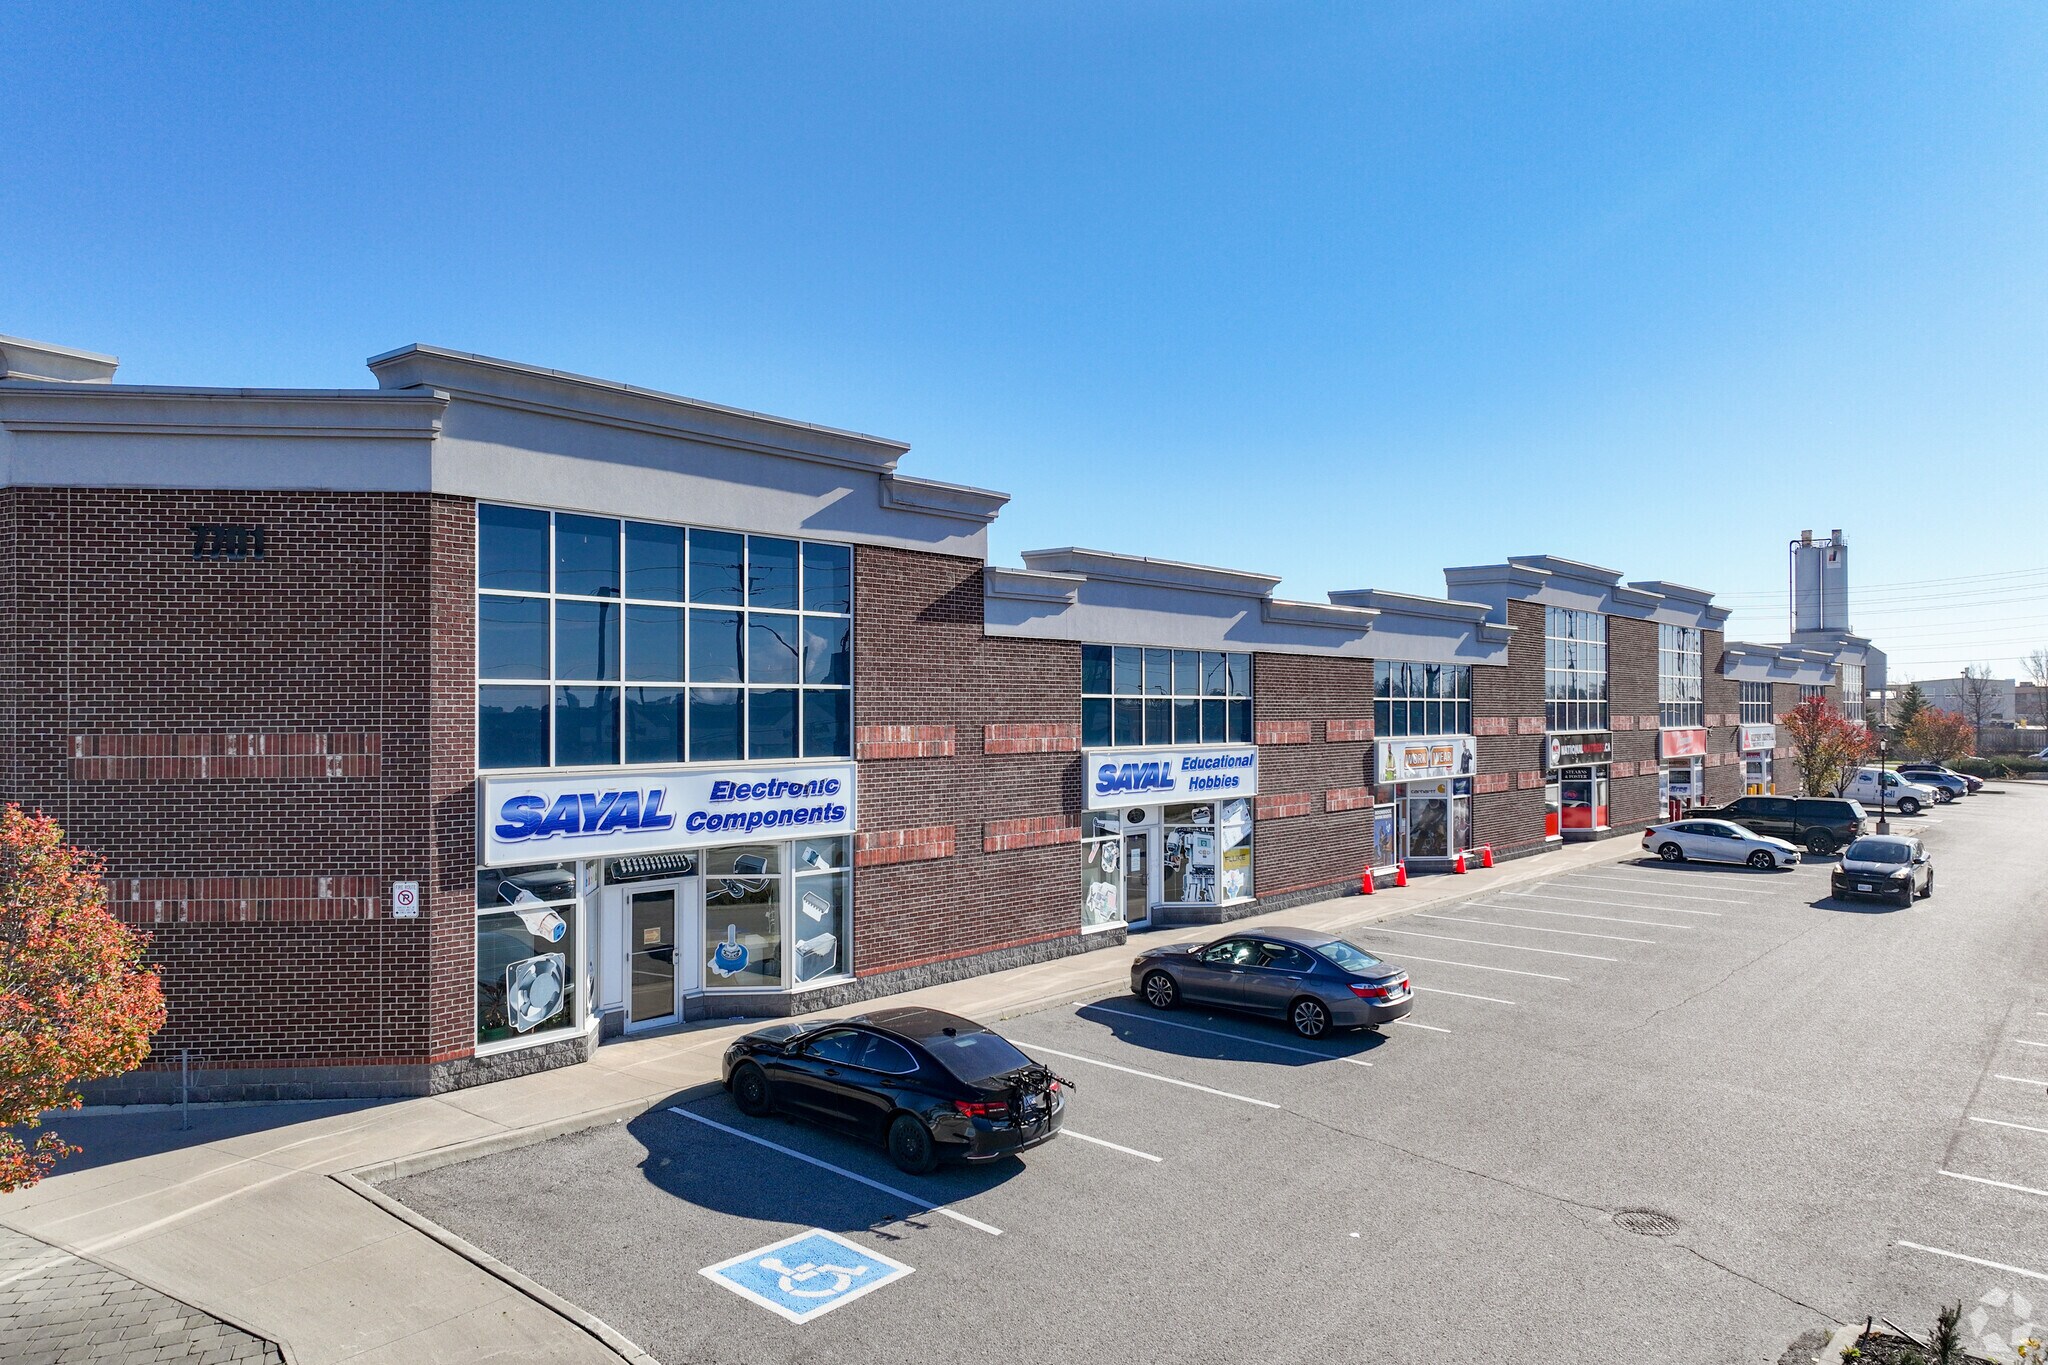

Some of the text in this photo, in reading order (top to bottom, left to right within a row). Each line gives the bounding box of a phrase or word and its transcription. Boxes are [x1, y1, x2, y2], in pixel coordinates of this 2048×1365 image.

[1181, 754, 1253, 771] Educational
[1405, 751, 1452, 765] WORK WEAR
[1096, 761, 1174, 793] SAYAL
[1188, 774, 1240, 791] Hobbies
[709, 777, 841, 802] Electronic
[495, 789, 673, 840] SAYAL
[685, 803, 846, 833] Components
[1224, 853, 1246, 863] FLUKE
